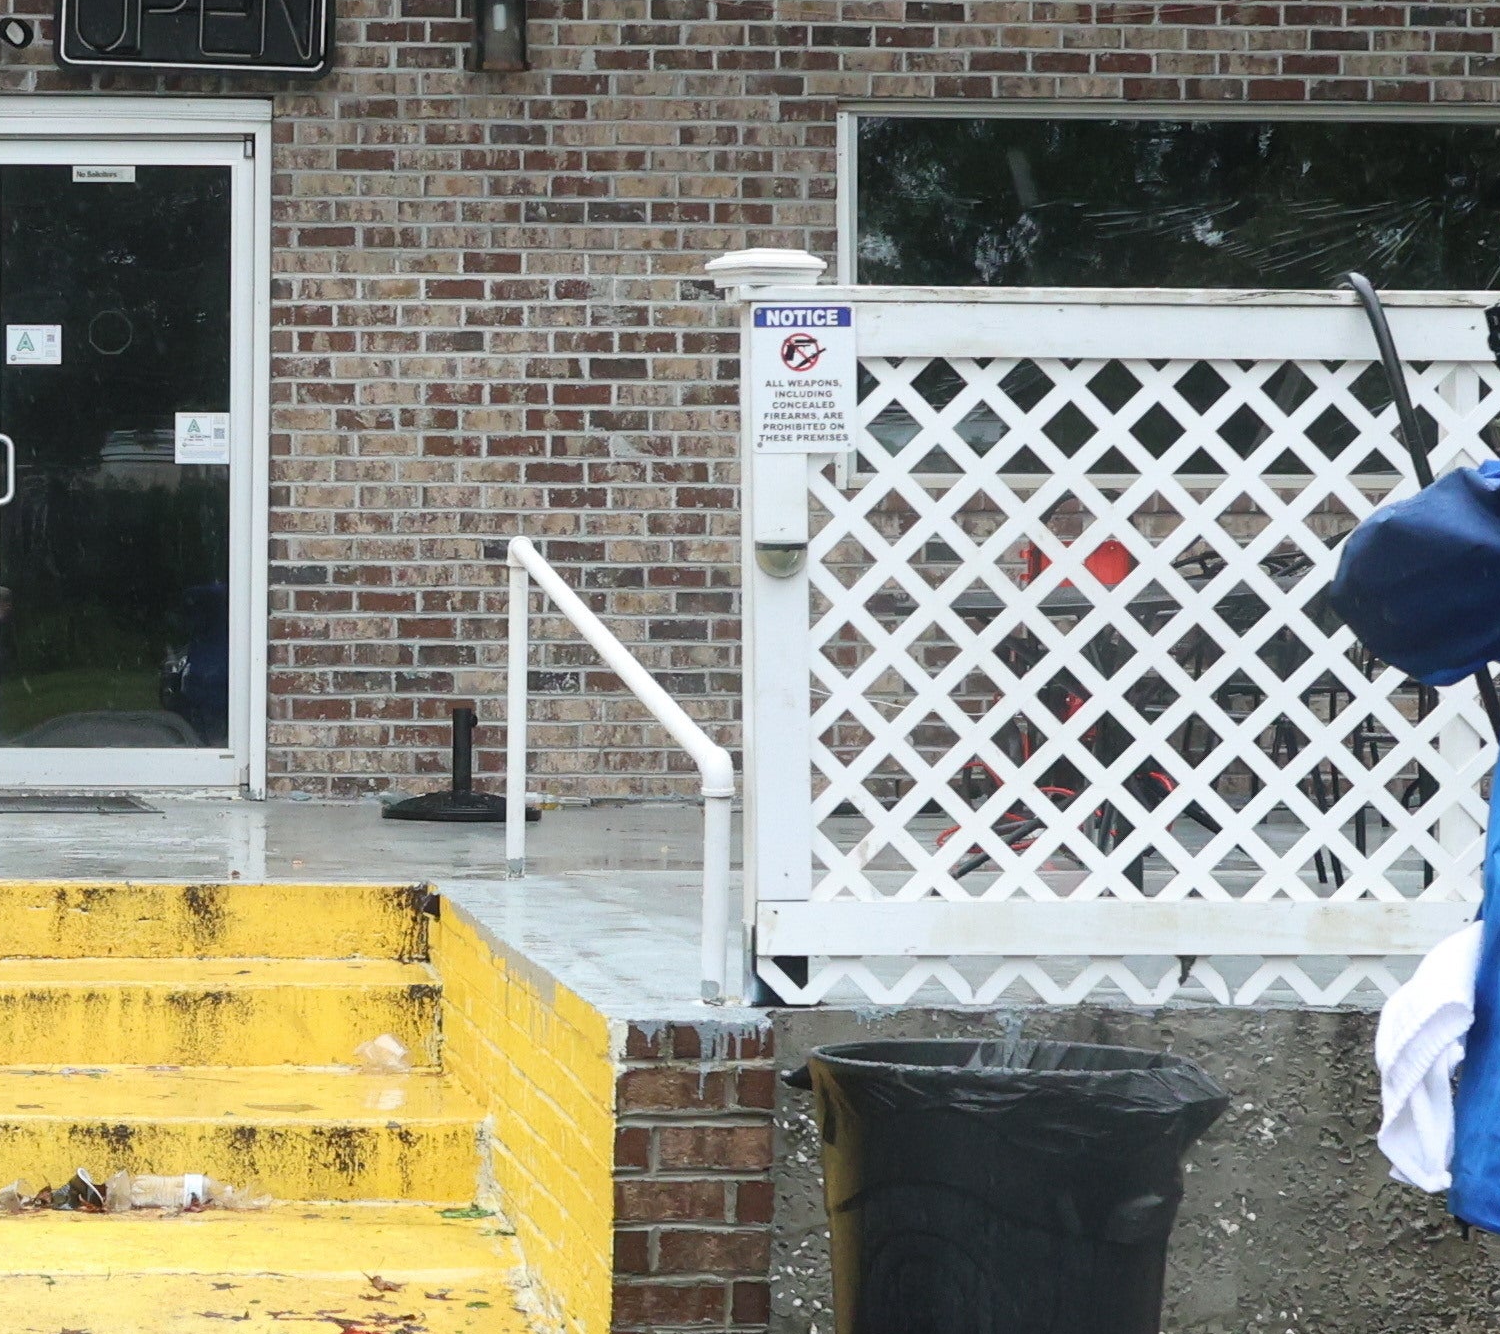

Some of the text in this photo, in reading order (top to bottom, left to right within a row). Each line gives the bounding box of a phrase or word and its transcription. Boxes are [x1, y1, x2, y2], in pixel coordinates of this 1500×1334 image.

[766, 309, 838, 326] NOTICE
[17, 332, 35, 351] A
[788, 379, 842, 388] WEAPONS,
[775, 390, 832, 398] INCLUDING
[772, 401, 835, 409] CONCEALED
[763, 412, 844, 420] FIREARMS, ARE
[187, 419, 200, 432] A
[763, 423, 826, 431] PROHIBITED
[759, 434, 793, 442] THESE
